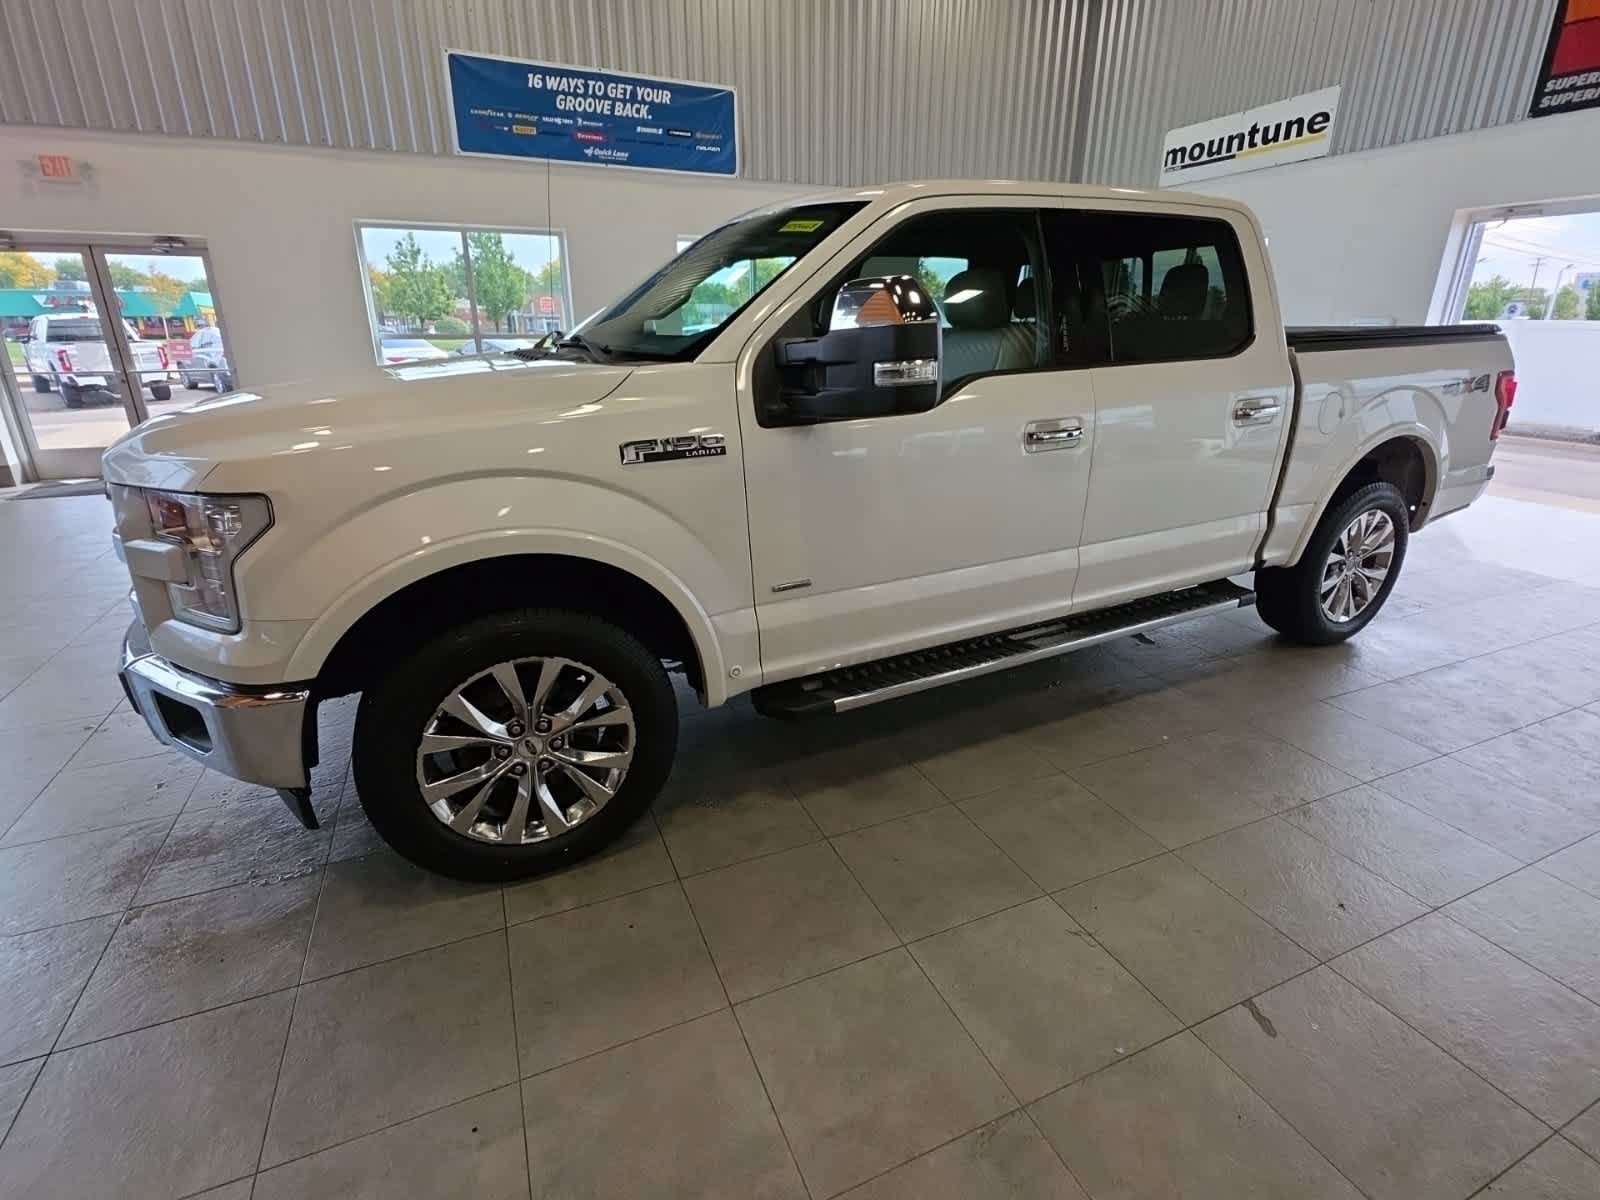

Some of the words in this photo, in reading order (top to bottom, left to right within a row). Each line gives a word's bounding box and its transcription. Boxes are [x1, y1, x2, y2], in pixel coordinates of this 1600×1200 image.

[527, 73, 543, 89] 16
[546, 75, 585, 95] WAYS
[587, 79, 605, 96] TO
[607, 83, 633, 100] GET
[636, 86, 672, 105] YOUR
[556, 94, 612, 116] GROOVE
[614, 100, 653, 120] BACK.
[1164, 111, 1331, 167] mountune
[39, 156, 72, 177] EXIT
[685, 447, 723, 457] LARIAT
